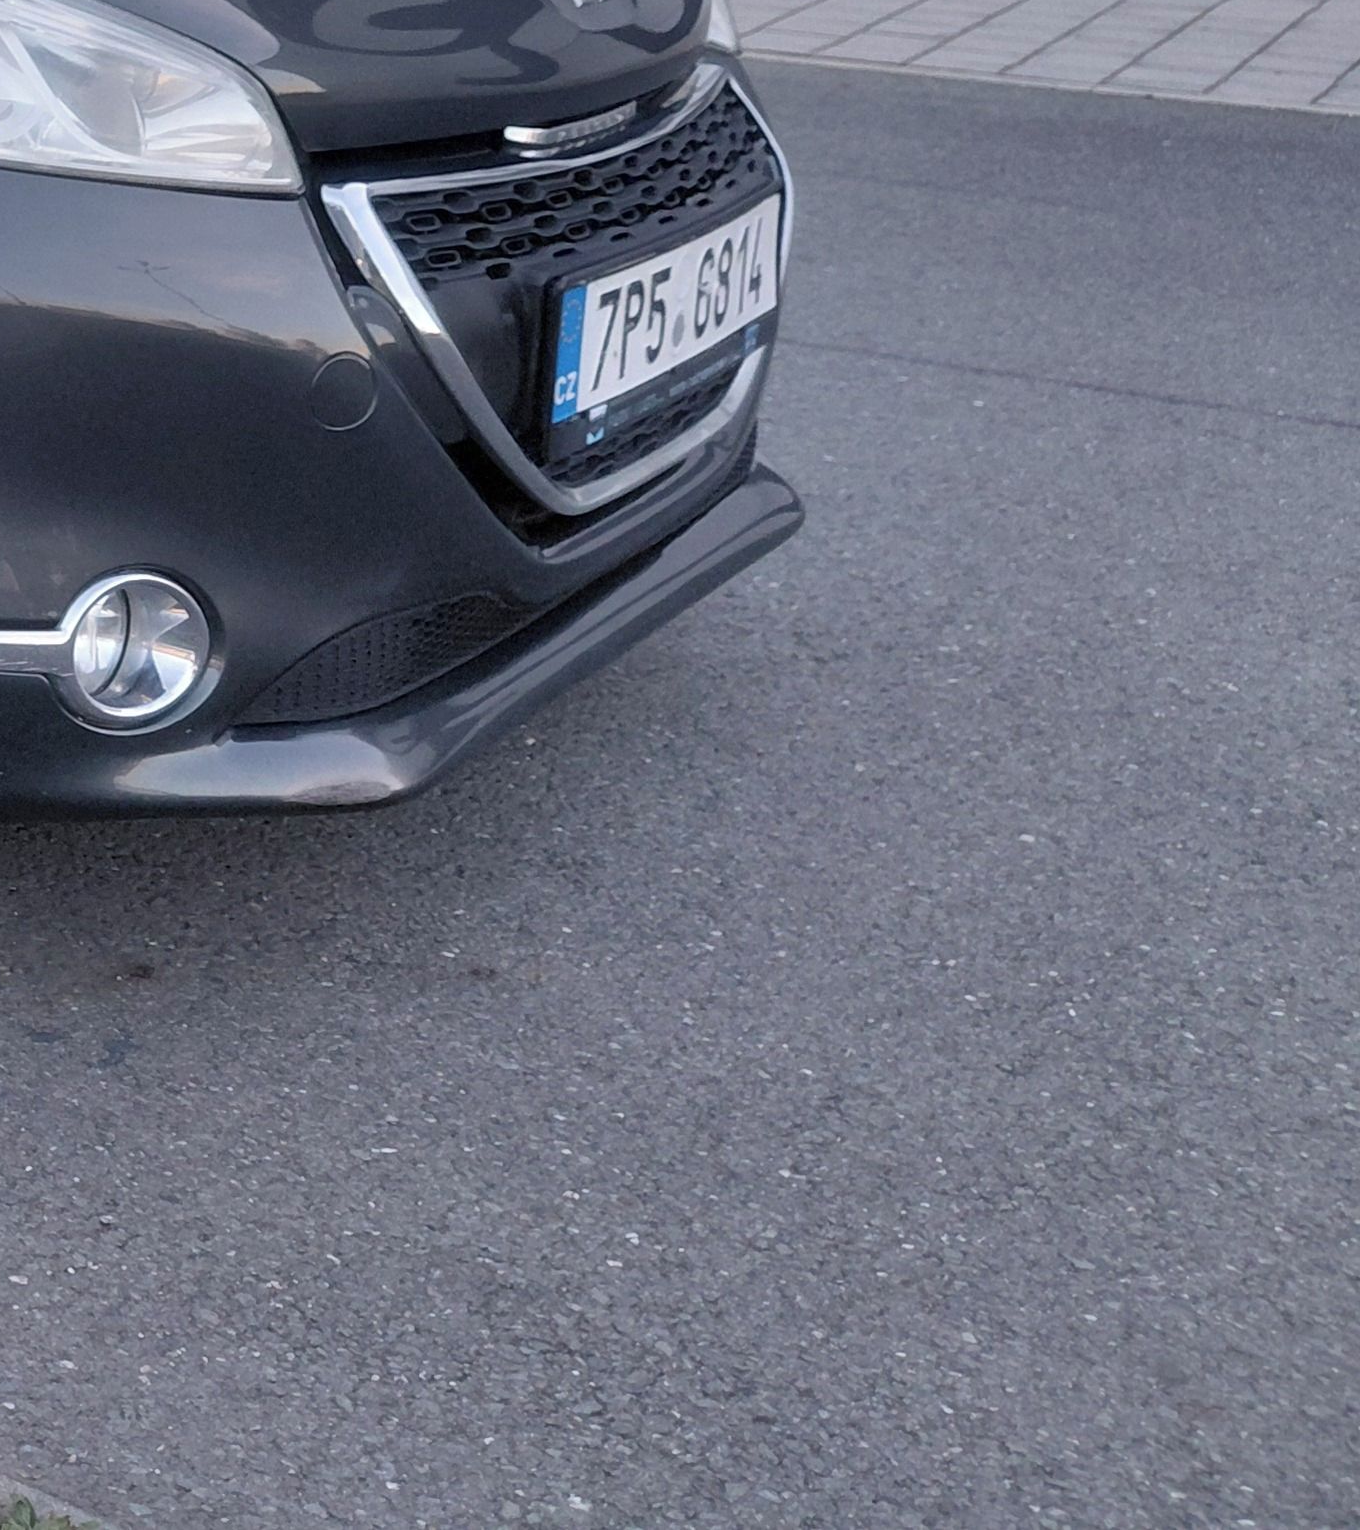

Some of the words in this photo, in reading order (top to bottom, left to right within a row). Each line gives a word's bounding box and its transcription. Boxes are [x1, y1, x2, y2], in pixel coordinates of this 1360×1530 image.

[591, 266, 672, 393] 7P5
[694, 217, 763, 339] 6814
[553, 371, 578, 405] CZ
